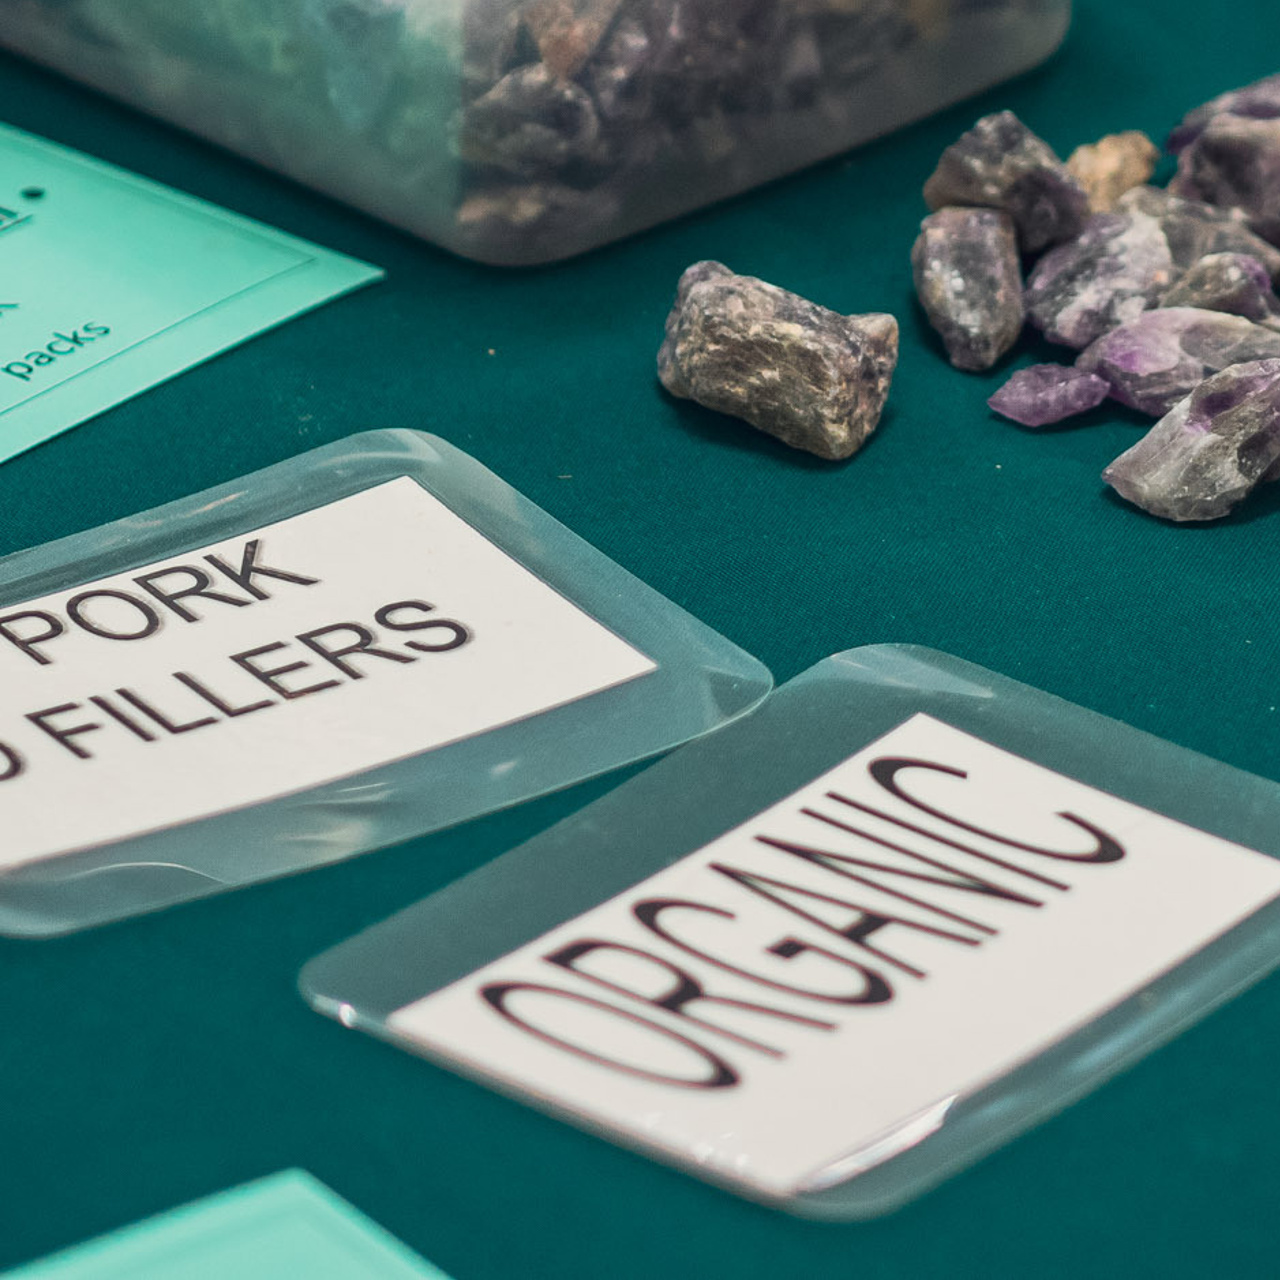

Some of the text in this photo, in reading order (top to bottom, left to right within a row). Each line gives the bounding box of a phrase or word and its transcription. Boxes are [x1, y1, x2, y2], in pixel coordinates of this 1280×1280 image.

[0, 321, 111, 382] packs
[0, 538, 320, 665] PORK
[24, 600, 472, 759] FILLERS
[476, 755, 1127, 1091] ORGANIC
